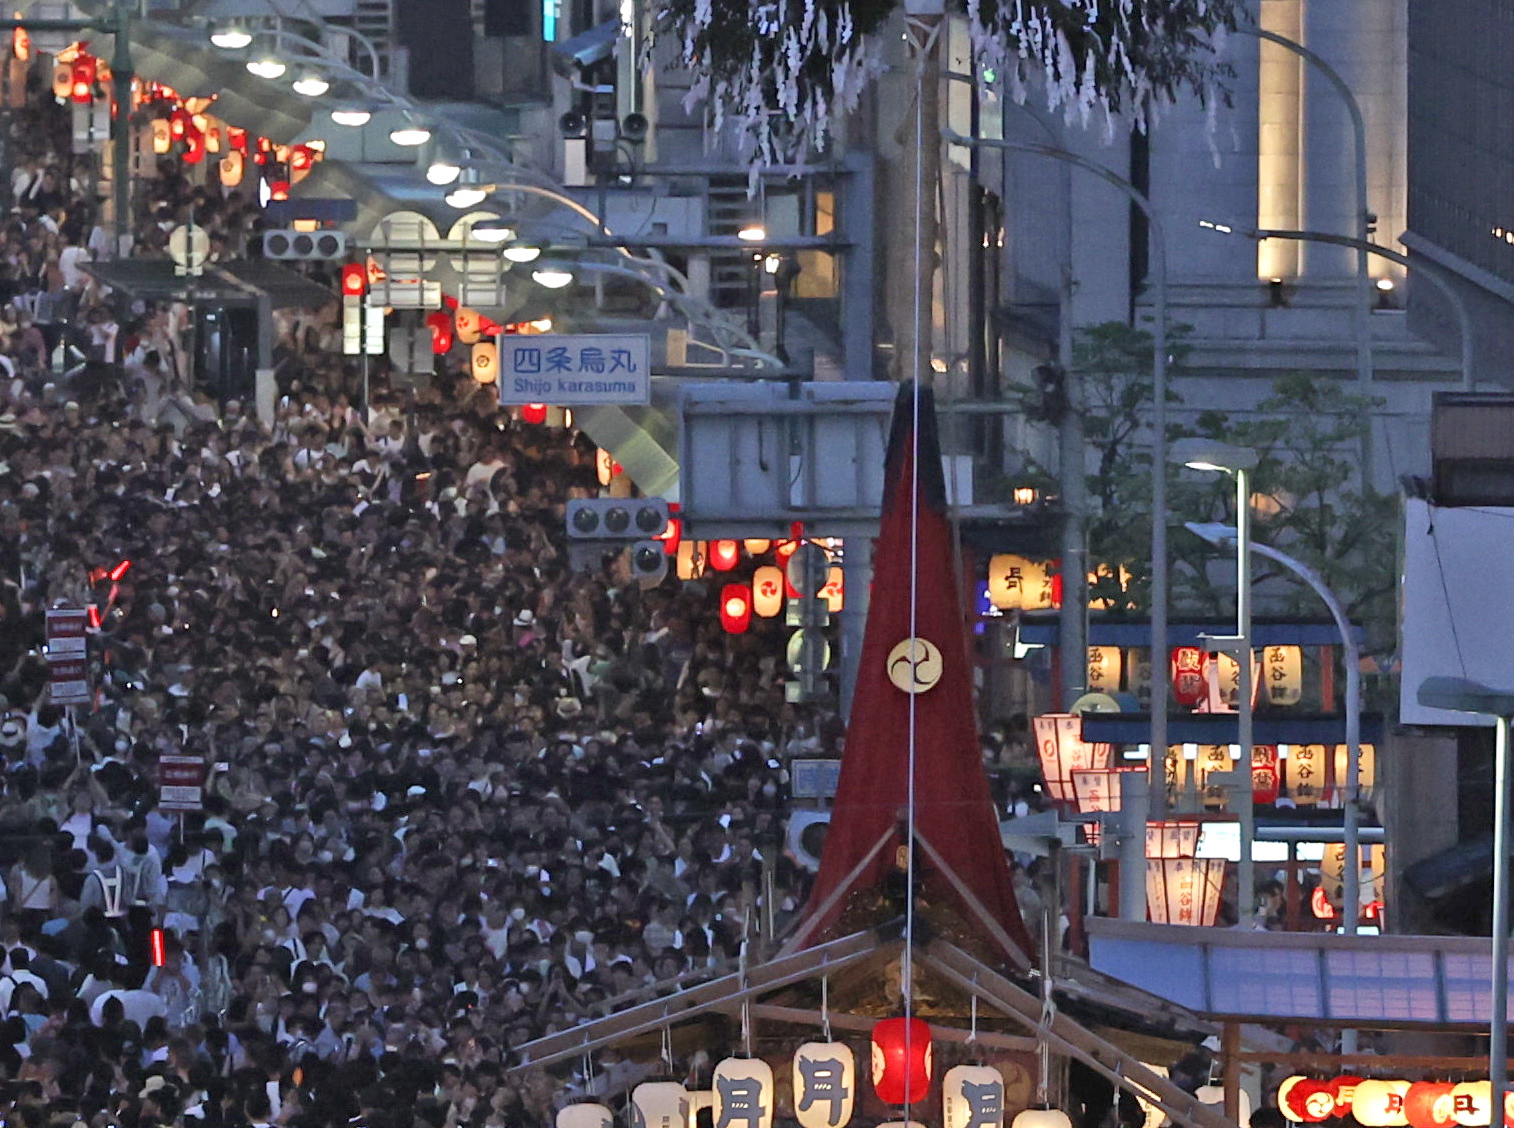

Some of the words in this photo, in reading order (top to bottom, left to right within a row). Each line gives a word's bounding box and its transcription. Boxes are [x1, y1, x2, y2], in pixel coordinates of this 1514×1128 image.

[514, 347, 636, 373] 四条烏丸
[514, 379, 551, 394] Shijo
[558, 379, 635, 392] karasuma
